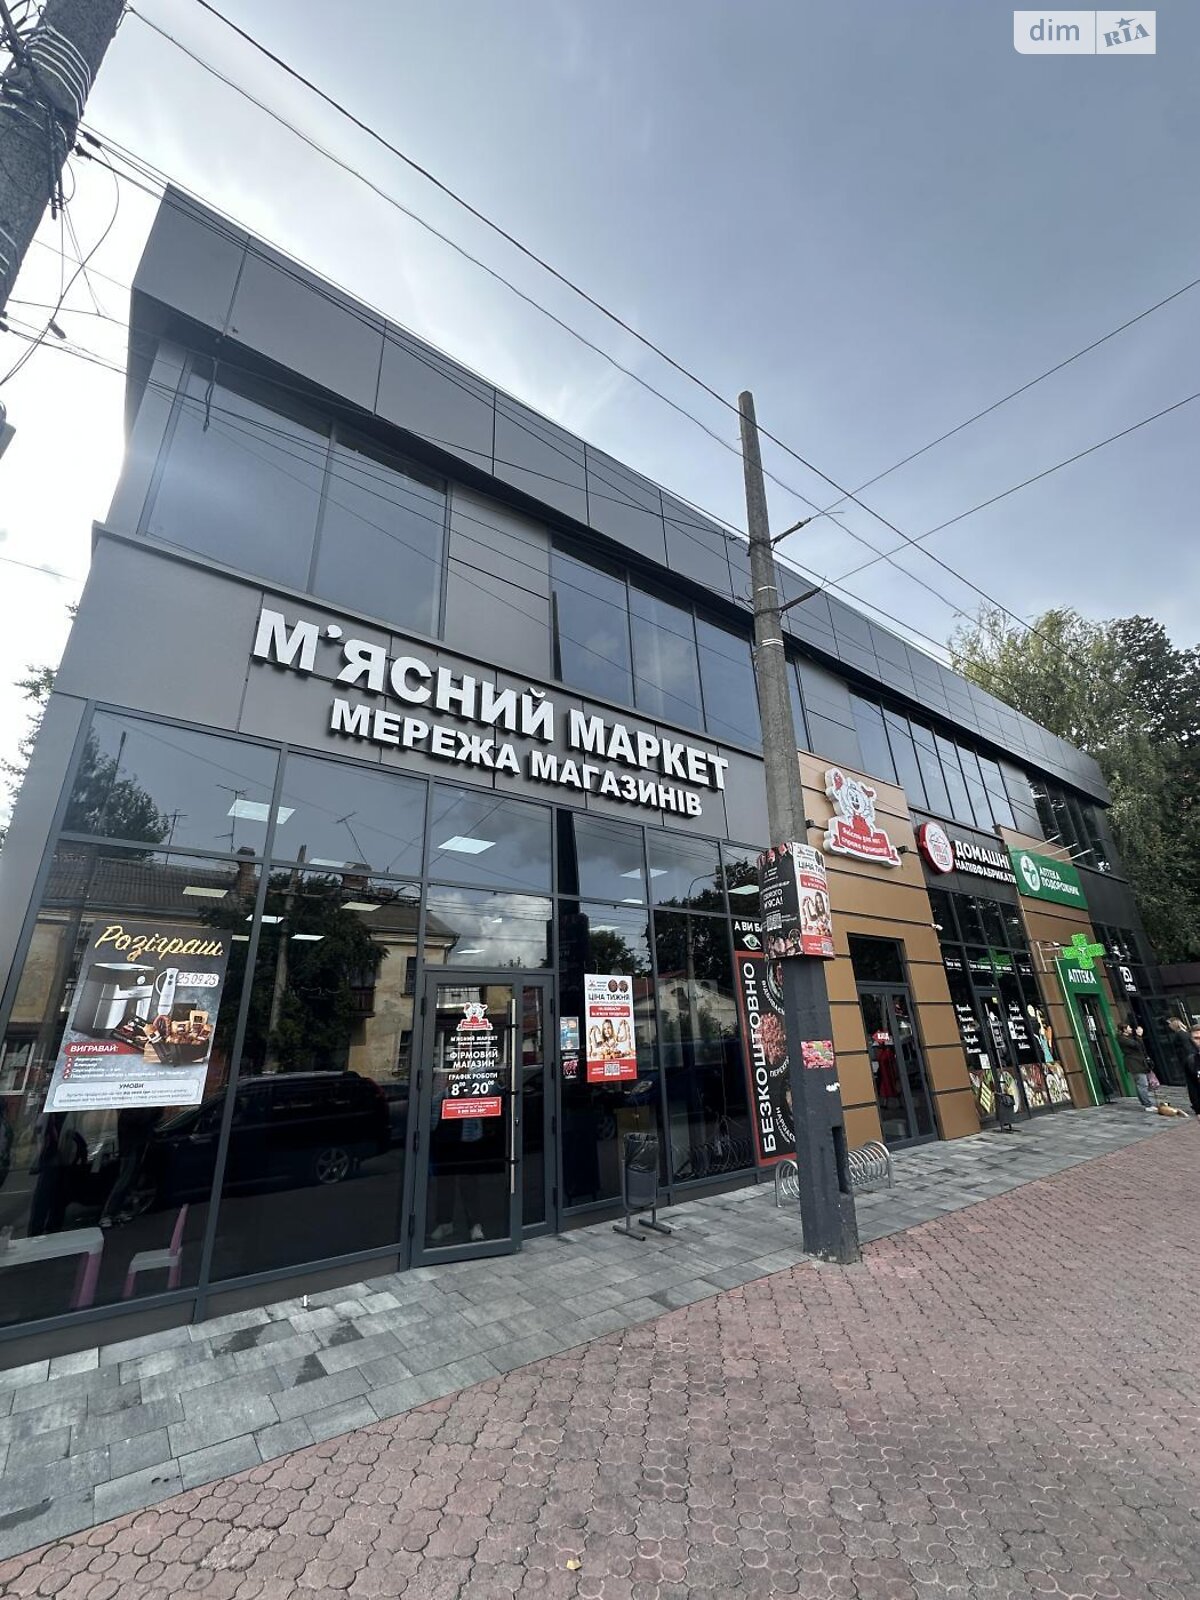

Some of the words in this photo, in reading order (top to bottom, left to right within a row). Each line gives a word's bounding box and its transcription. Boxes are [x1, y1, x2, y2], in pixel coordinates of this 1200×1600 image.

[253, 608, 555, 744] М'ЯСНИЙ
[568, 708, 730, 791] МАРКЕТ
[330, 698, 521, 777] МЕРЕЖА
[529, 750, 703, 818] МАГАЗИНІВ
[954, 840, 1010, 871] ДОМАШНІ
[1039, 867, 1061, 881] АПТЕКА
[734, 920, 741, 931] А
[741, 921, 754, 932] ВИ
[94, 926, 224, 963] Розіграш
[1067, 969, 1097, 984] АПТЕКА
[449, 1048, 498, 1060] ФІРМОВИЙ
[453, 1060, 495, 1069] МАГАЗИН
[743, 962, 777, 1153] БЕЗКОШТОВНО
